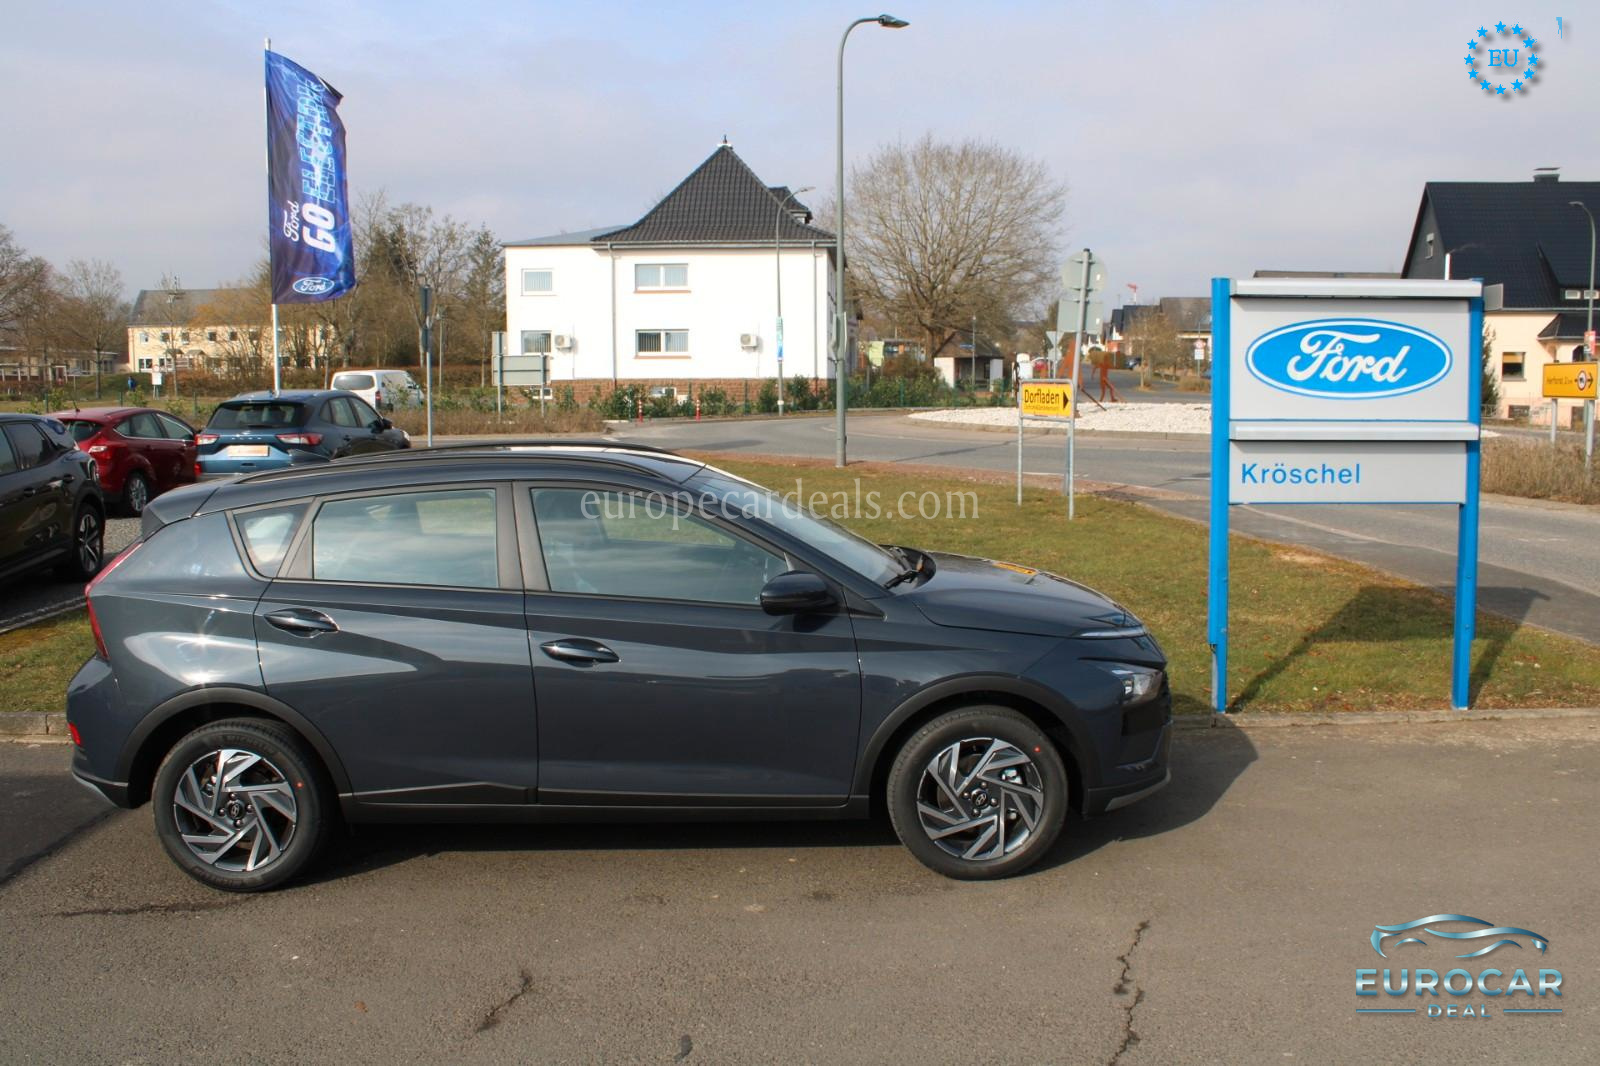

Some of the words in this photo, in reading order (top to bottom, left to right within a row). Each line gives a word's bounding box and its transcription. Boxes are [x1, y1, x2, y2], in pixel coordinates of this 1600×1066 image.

[283, 199, 300, 242] Ford
[302, 202, 336, 253] GO
[1286, 330, 1411, 383] Ford
[1024, 388, 1060, 405] Dorfladen
[1241, 462, 1361, 485] Kröschel
